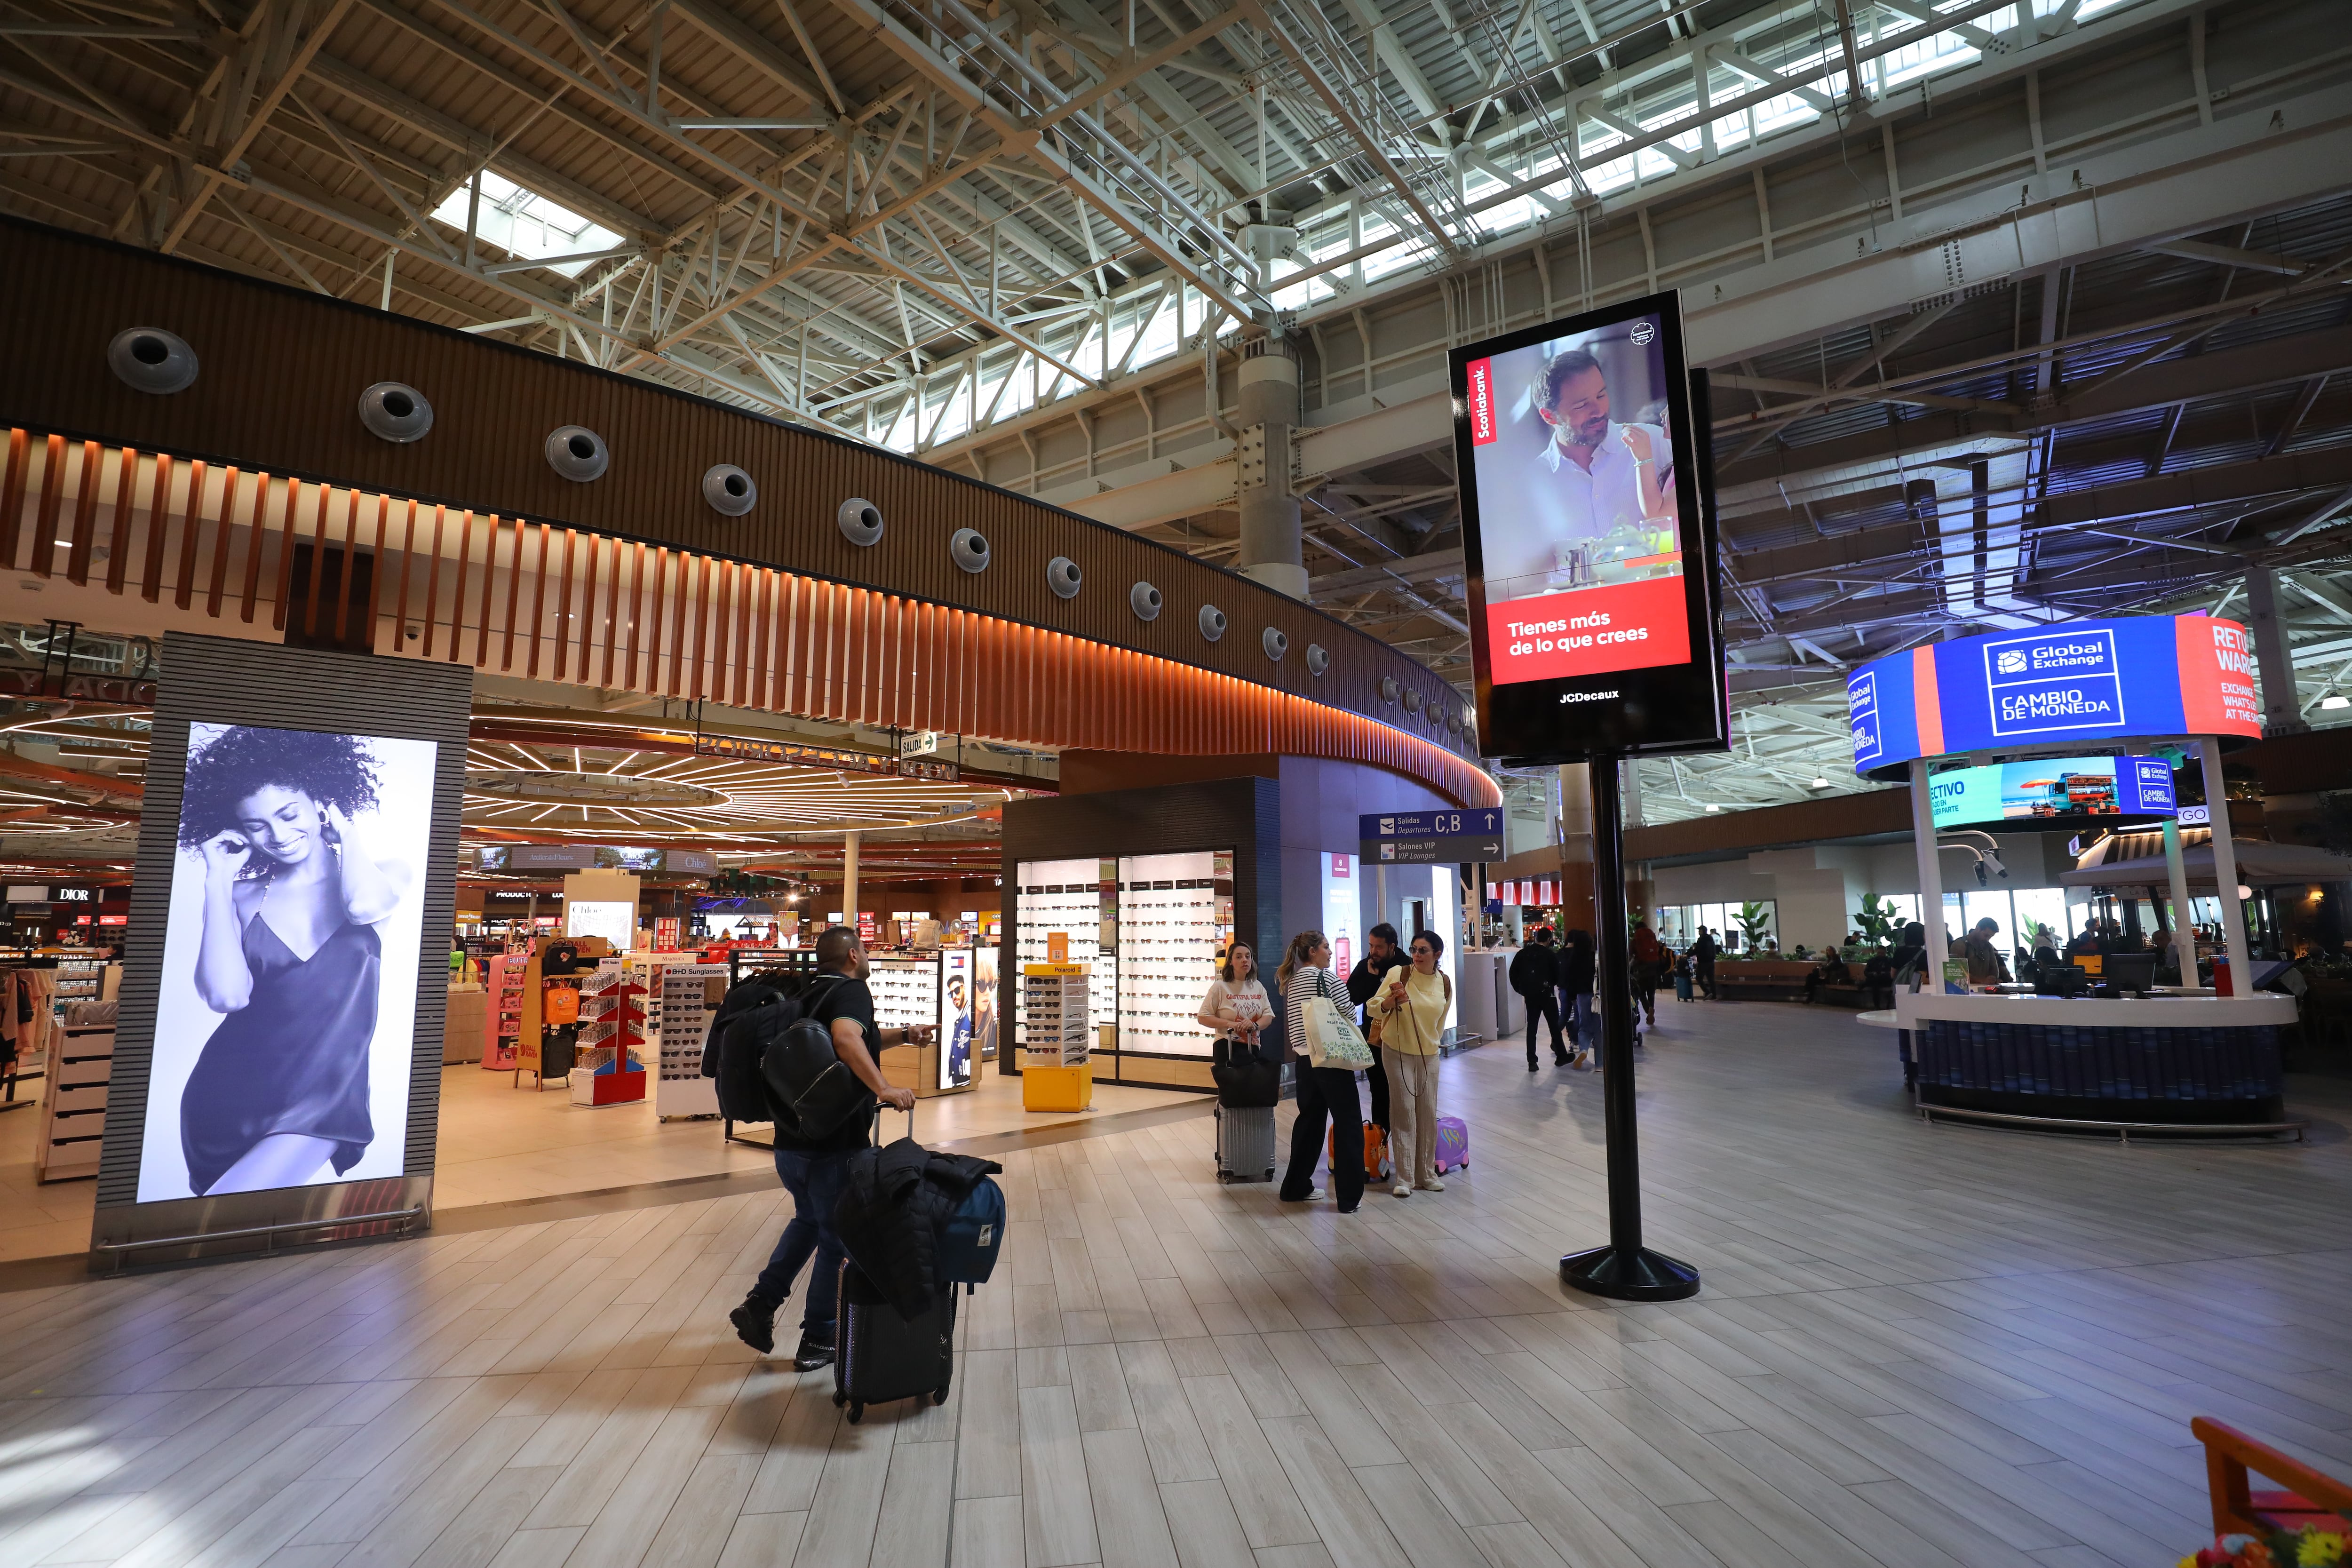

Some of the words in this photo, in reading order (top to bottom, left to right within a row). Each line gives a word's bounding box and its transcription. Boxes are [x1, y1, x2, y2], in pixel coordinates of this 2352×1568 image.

[1507, 619, 1566, 637] Tienes
[1570, 610, 1610, 629] más
[1510, 641, 1533, 656] de
[1536, 638, 1553, 653] lo
[1557, 635, 1592, 652] que
[1597, 627, 1648, 645] crees
[2032, 641, 2103, 659] Global
[2034, 655, 2104, 669] Exchange
[1559, 690, 1619, 703] JCDecaux
[1851, 683, 1870, 699] Global
[2221, 682, 2254, 699] EXCHANGE
[1852, 695, 1871, 711] Exchange
[2002, 689, 2083, 710] CAMBIO
[2223, 695, 2250, 709] WHAT'S
[2002, 708, 2026, 721] DE
[2031, 700, 2111, 718] MONEDA
[2225, 708, 2237, 719] AT
[2238, 709, 2250, 722] THE
[903, 740, 922, 754] SALIDA
[1854, 735, 1875, 752] MONEDA
[1942, 805, 1959, 814] PARTE
[1435, 814, 1461, 834] C,B
[1410, 852, 1435, 860] Lounges
[60, 889, 88, 901] DIOR
